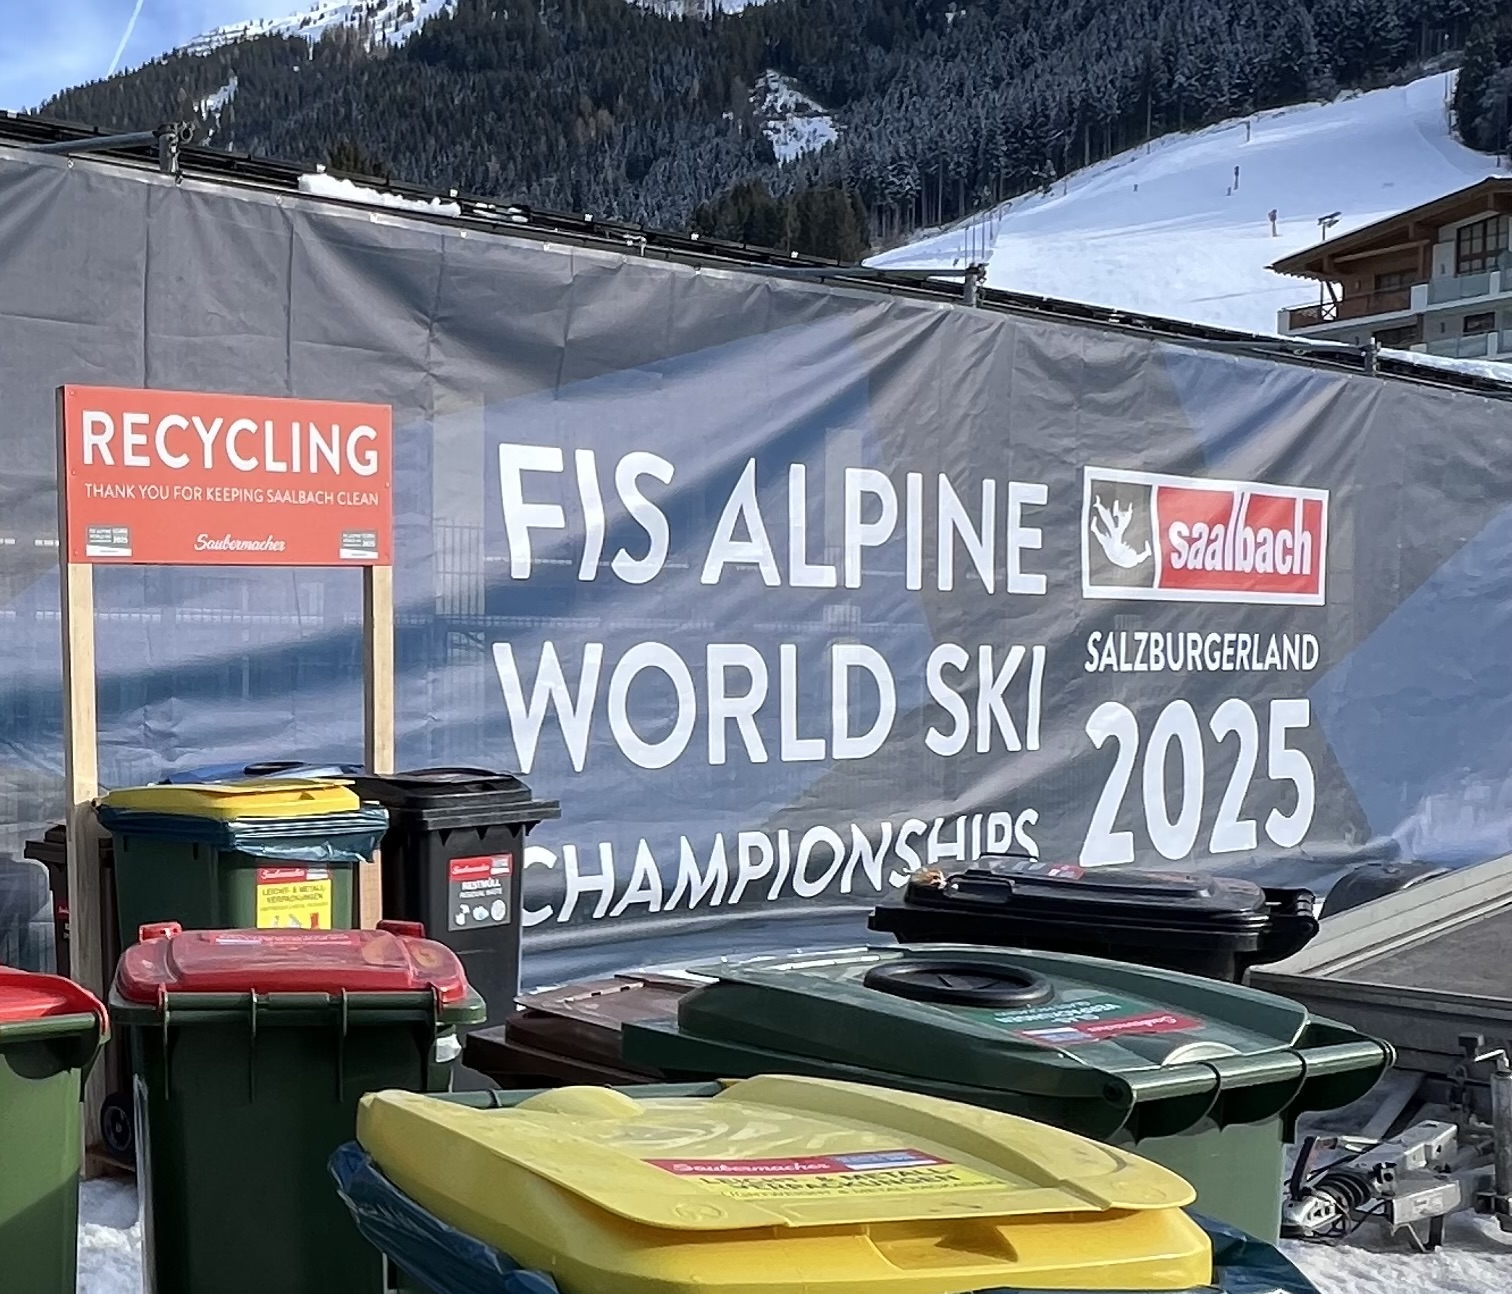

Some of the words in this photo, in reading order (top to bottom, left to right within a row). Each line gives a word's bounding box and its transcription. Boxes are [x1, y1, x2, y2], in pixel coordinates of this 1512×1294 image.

[82, 410, 379, 477] RECYCLING
[84, 483, 136, 500] THANK
[138, 484, 169, 501] YOU
[173, 486, 203, 502] FOR
[206, 487, 264, 503] KEEPING
[266, 489, 335, 505] SAALBACH
[336, 491, 379, 506] CLEAN
[498, 442, 676, 586] FIS
[700, 456, 1049, 596] ALPINE
[194, 533, 286, 552] Saubermacher
[1168, 490, 1313, 576] saalbach
[1084, 630, 1320, 673] SALZBURGERLAND
[492, 641, 898, 775] WORLD
[924, 641, 1048, 757] SKI
[1079, 697, 1317, 868] 2025
